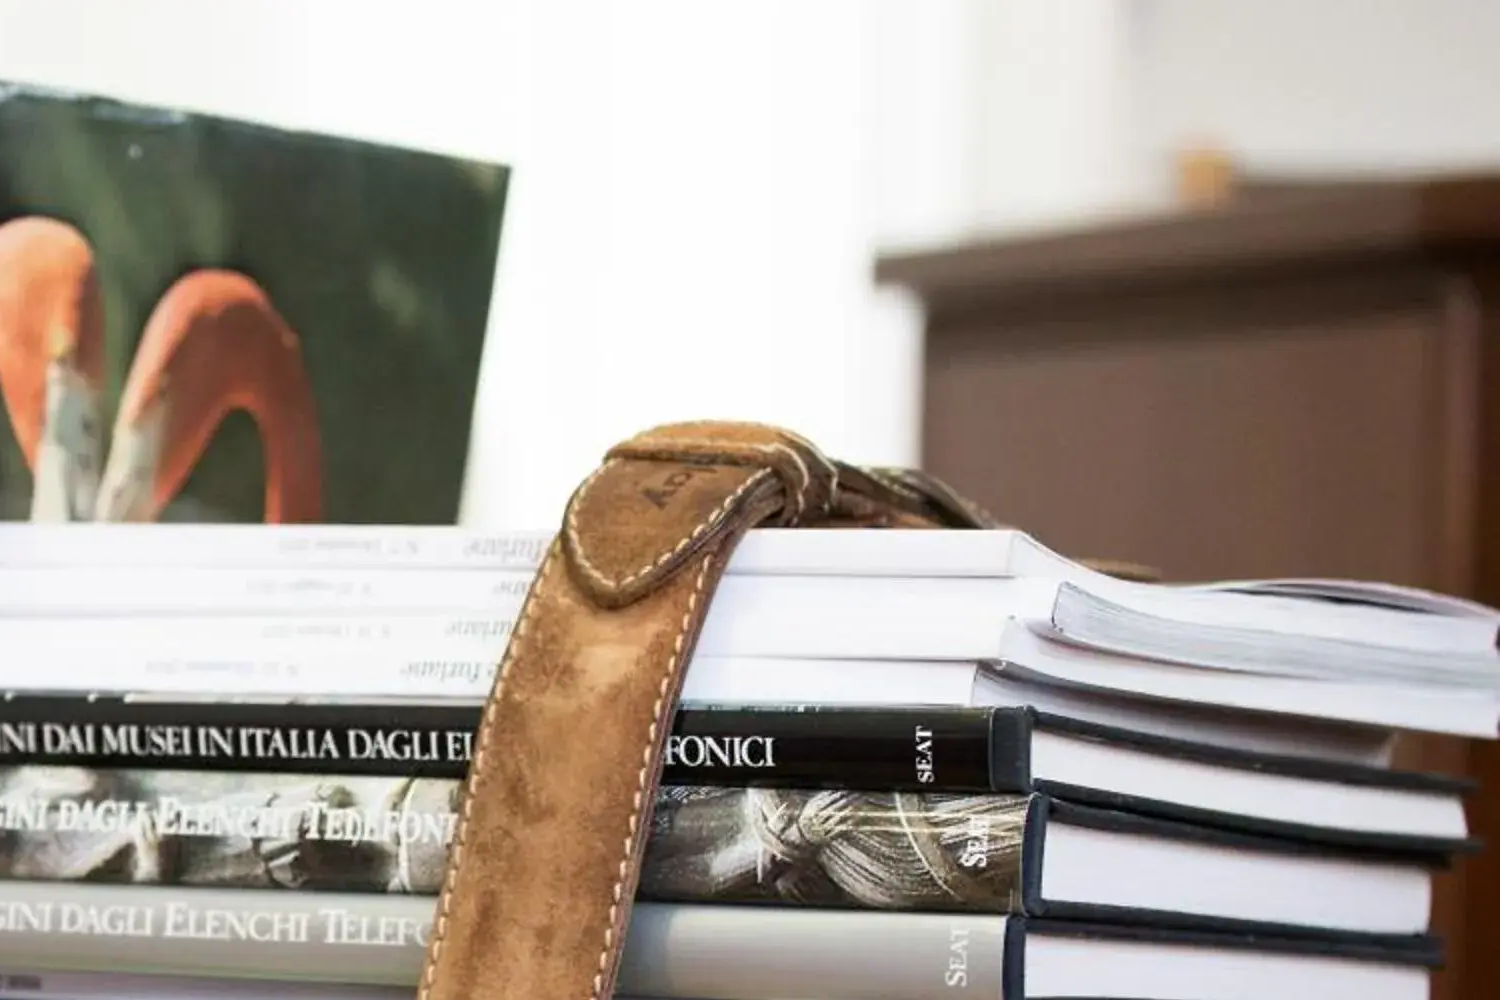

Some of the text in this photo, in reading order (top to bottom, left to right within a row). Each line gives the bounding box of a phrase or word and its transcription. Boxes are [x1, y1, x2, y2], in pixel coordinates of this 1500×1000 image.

[44, 722, 97, 757] DAI
[103, 724, 192, 758] MUSEI
[197, 725, 233, 757] IN
[240, 728, 340, 760] ITALIA
[348, 729, 439, 763] DAGLI
[662, 735, 775, 768] FONICI
[916, 725, 934, 784] SEAT
[57, 798, 144, 833] DAGLI
[158, 800, 294, 840] ELENCHI
[302, 803, 458, 846] TELEFONI
[60, 903, 154, 936] DAGLI
[162, 902, 311, 943] ELENCHI
[944, 926, 971, 988] SEAT
